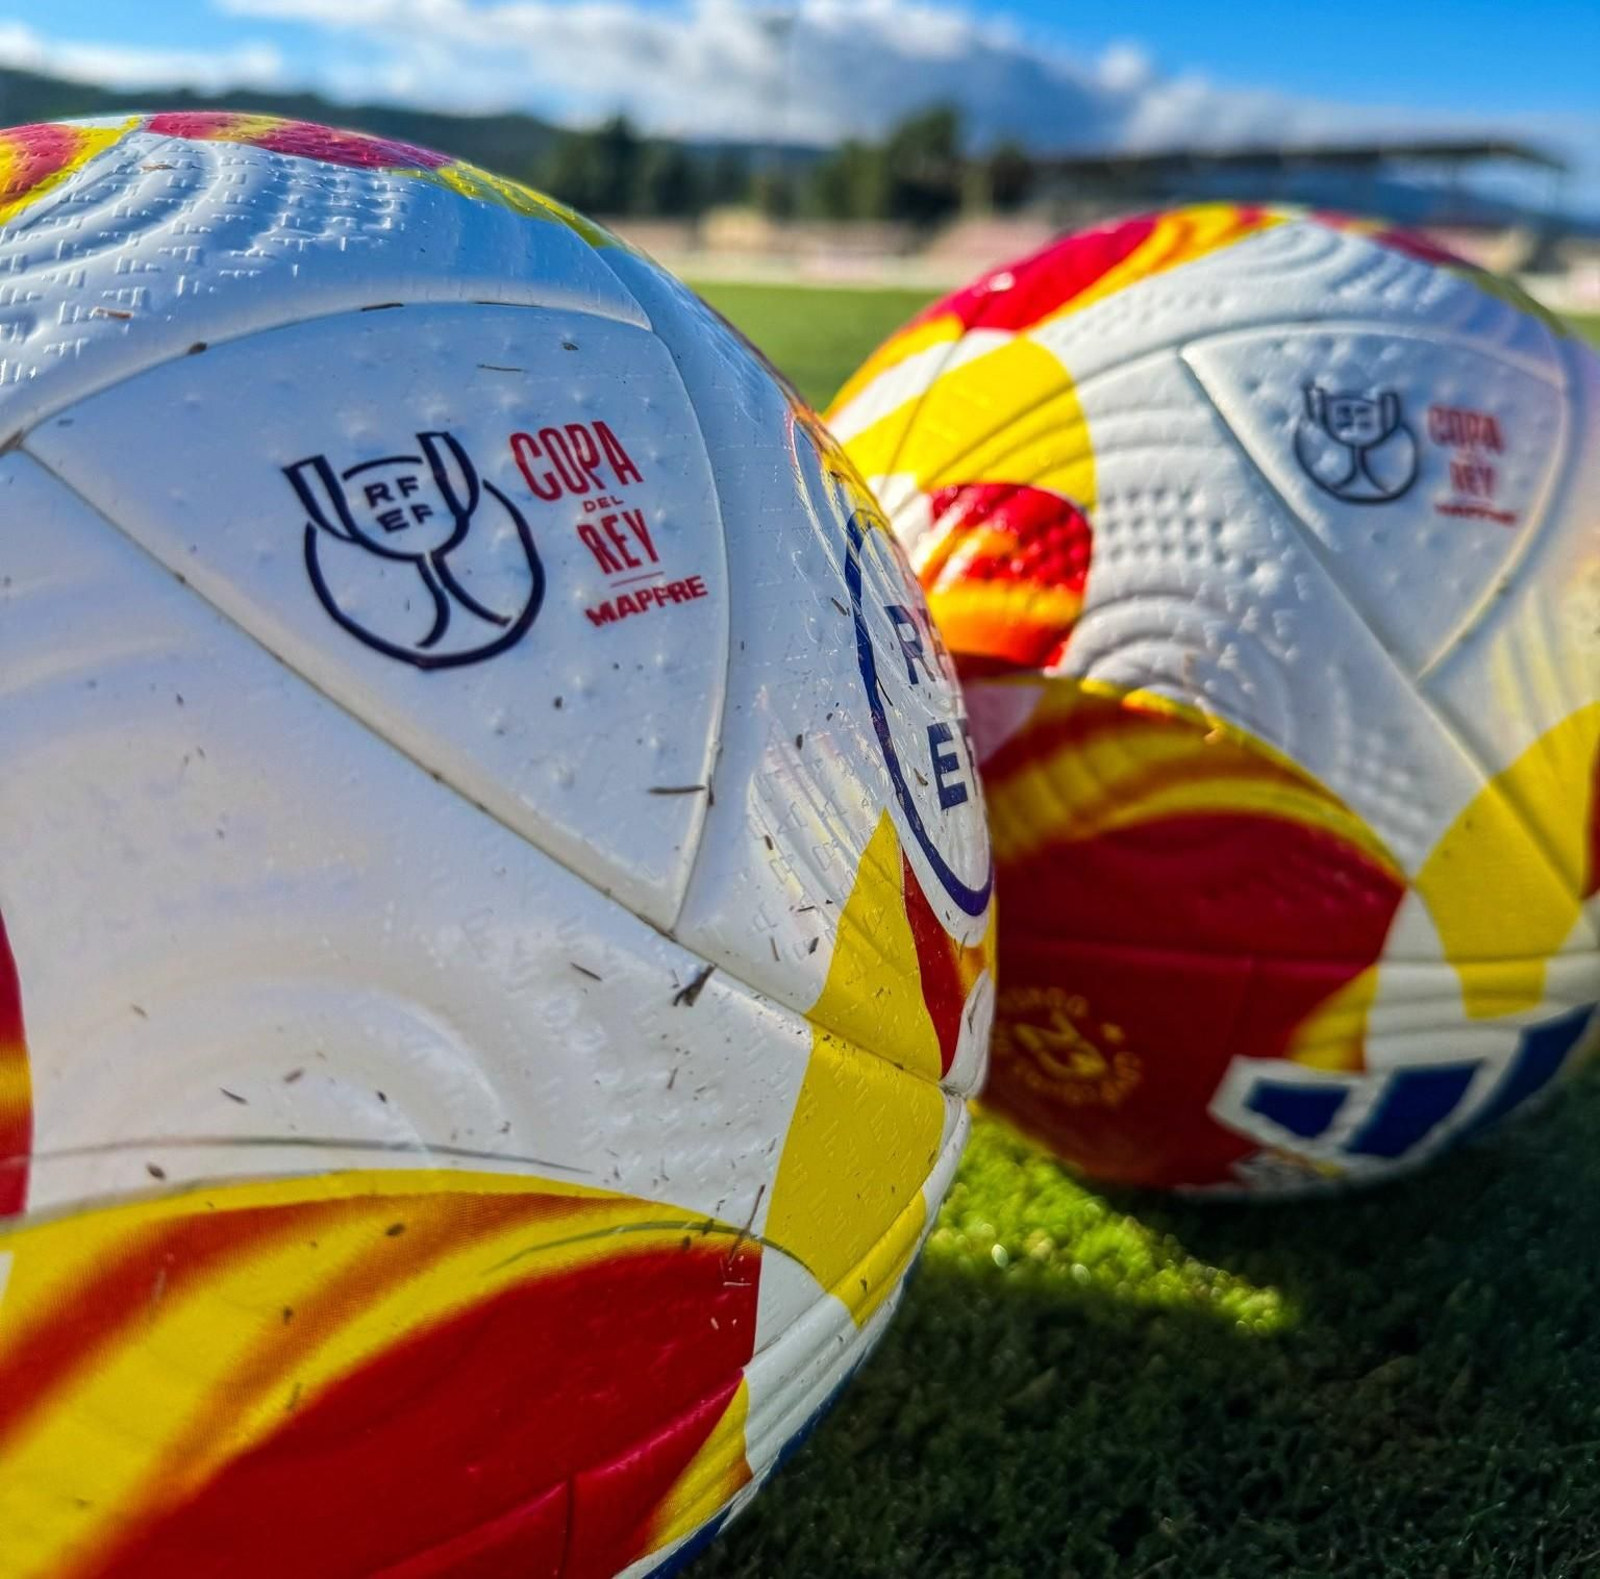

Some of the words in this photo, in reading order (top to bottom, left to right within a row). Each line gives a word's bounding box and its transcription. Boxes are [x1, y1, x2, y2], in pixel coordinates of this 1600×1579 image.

[509, 420, 644, 501] COPA
[364, 475, 419, 508] RF
[583, 496, 624, 513] DEL
[376, 504, 434, 533] EF
[576, 509, 660, 575] REY
[584, 575, 708, 627] MAPFRE
